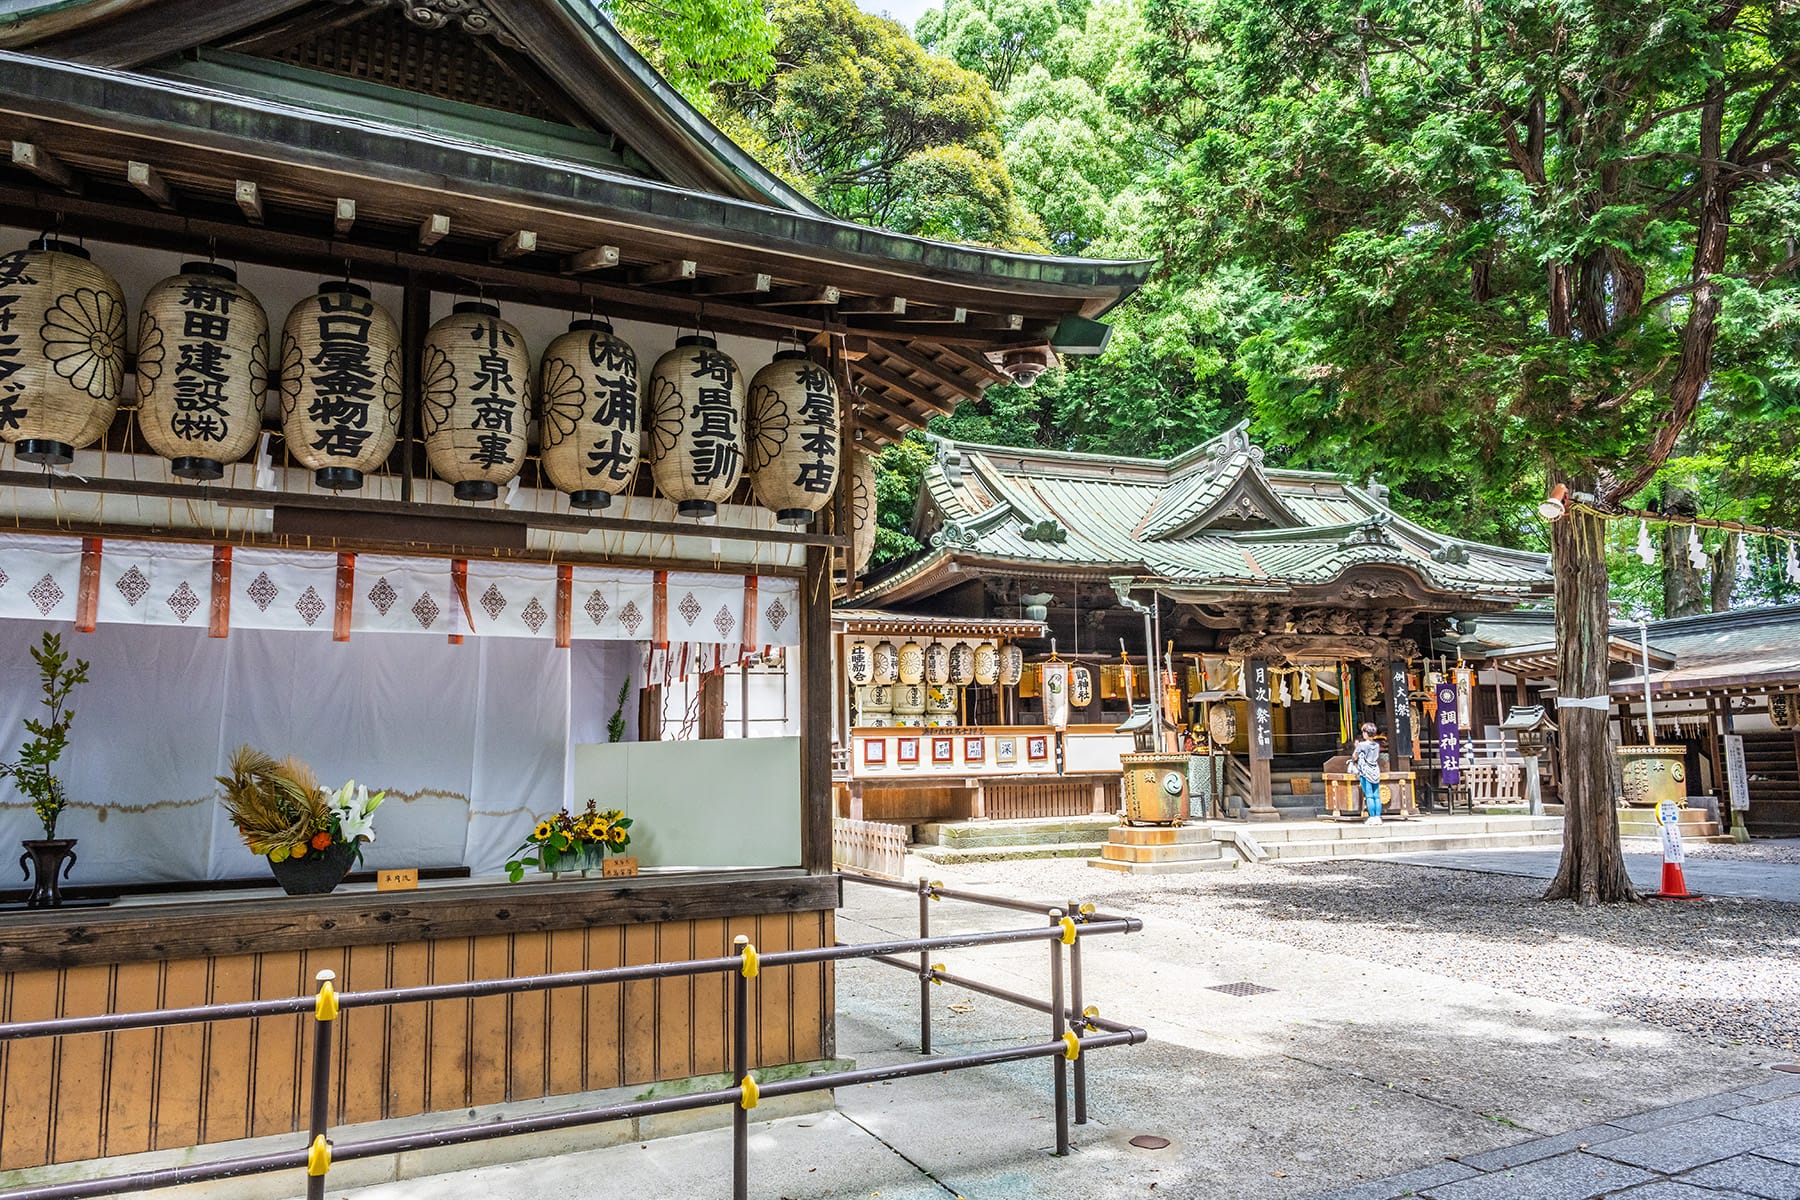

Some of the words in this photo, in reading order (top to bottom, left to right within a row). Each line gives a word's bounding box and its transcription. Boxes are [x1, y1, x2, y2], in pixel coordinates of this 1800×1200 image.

[308, 293, 377, 458] 山口屋金物店
[469, 318, 517, 470] 小泉商事
[792, 365, 837, 494] 柳屋本店
[1256, 667, 1271, 724] 月次祭
[1440, 710, 1459, 771] 調神社
